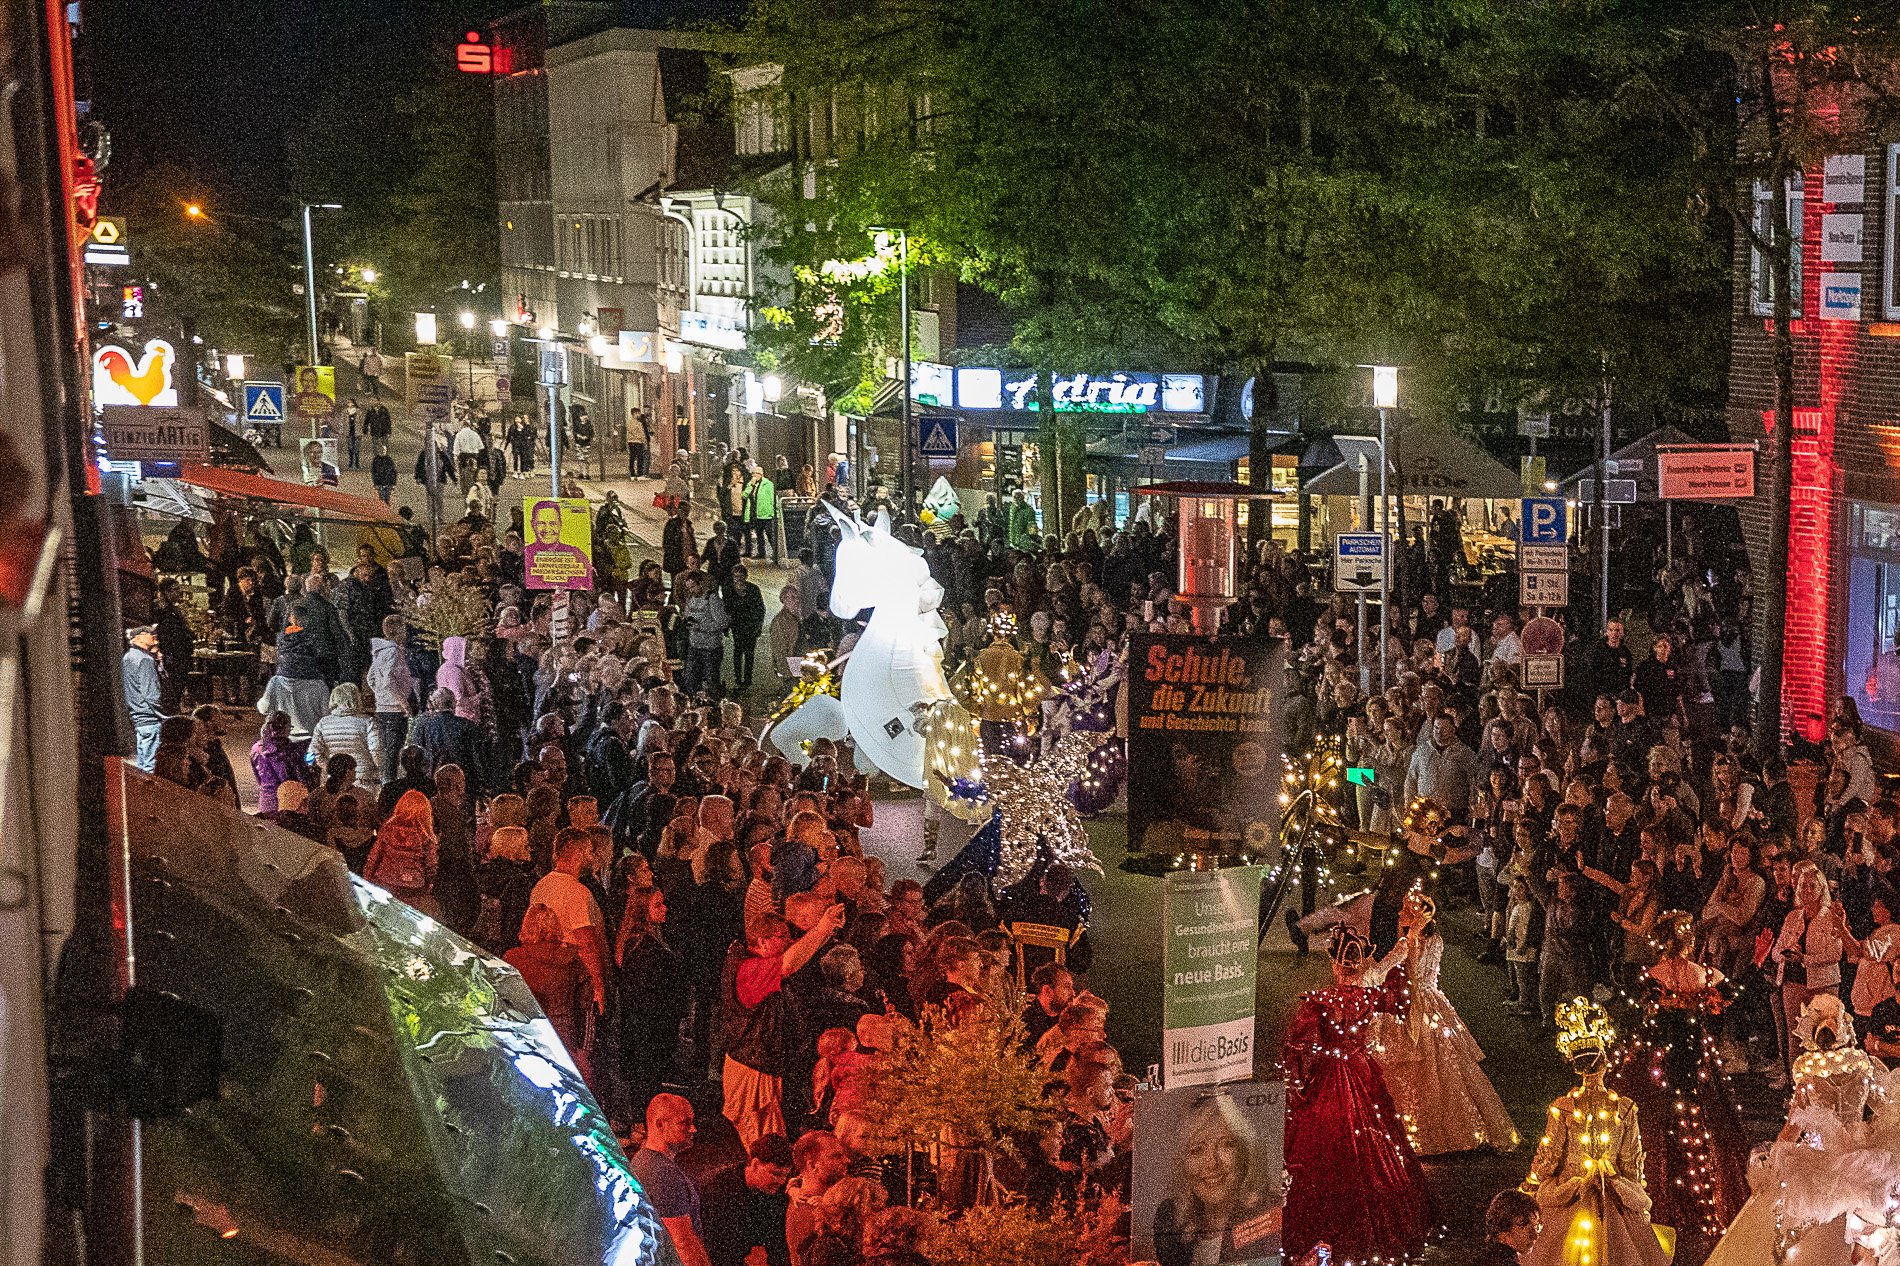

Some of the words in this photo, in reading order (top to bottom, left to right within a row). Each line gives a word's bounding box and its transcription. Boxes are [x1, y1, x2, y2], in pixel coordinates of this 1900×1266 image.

[1532, 503, 1557, 538] P
[1145, 645, 1252, 688] Schule,
[1152, 684, 1186, 712] die
[1189, 685, 1272, 714] Zukunft
[1140, 714, 1164, 729] und
[1166, 715, 1237, 732] Geschichte
[1188, 940, 1231, 959] braucht
[1232, 938, 1251, 953] eine
[1174, 970, 1212, 986] neue
[1214, 960, 1246, 982] Basis.
[1191, 1031, 1249, 1063] dieBasis
[1245, 1093, 1280, 1107] CDU
